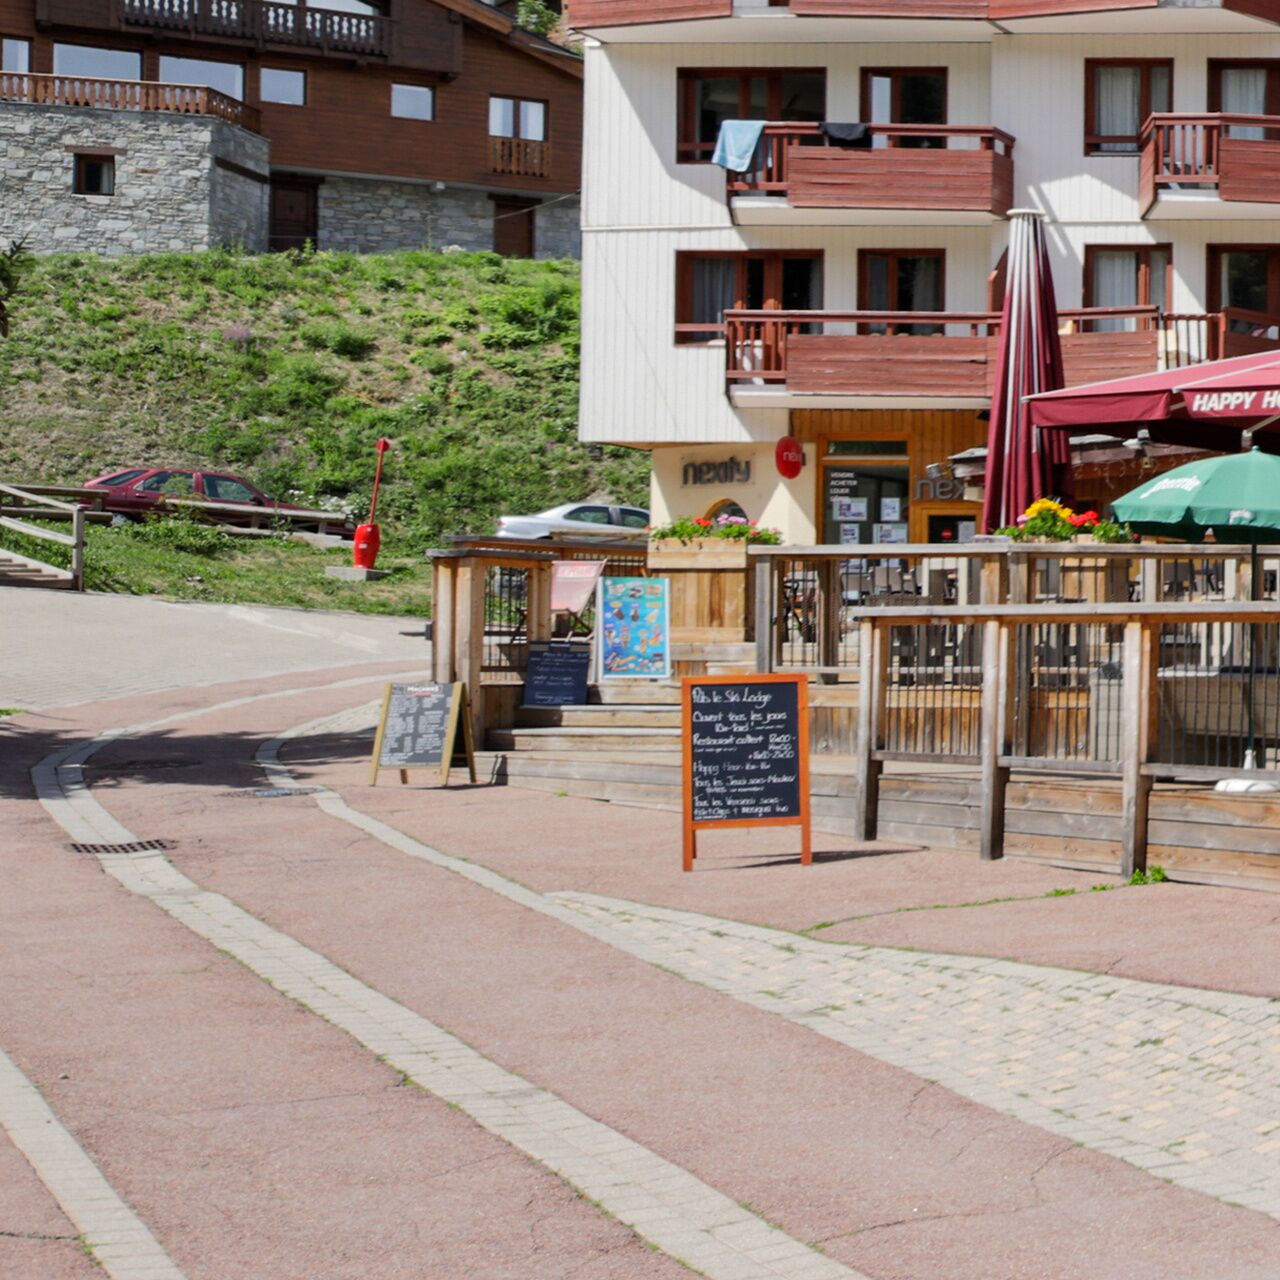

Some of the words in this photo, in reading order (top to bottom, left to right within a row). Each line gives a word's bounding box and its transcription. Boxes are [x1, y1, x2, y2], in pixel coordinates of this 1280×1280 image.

[1192, 391, 1257, 412] HAPPY
[682, 456, 751, 486] nexity
[912, 479, 964, 500] nex
[742, 687, 772, 709] Lodge
